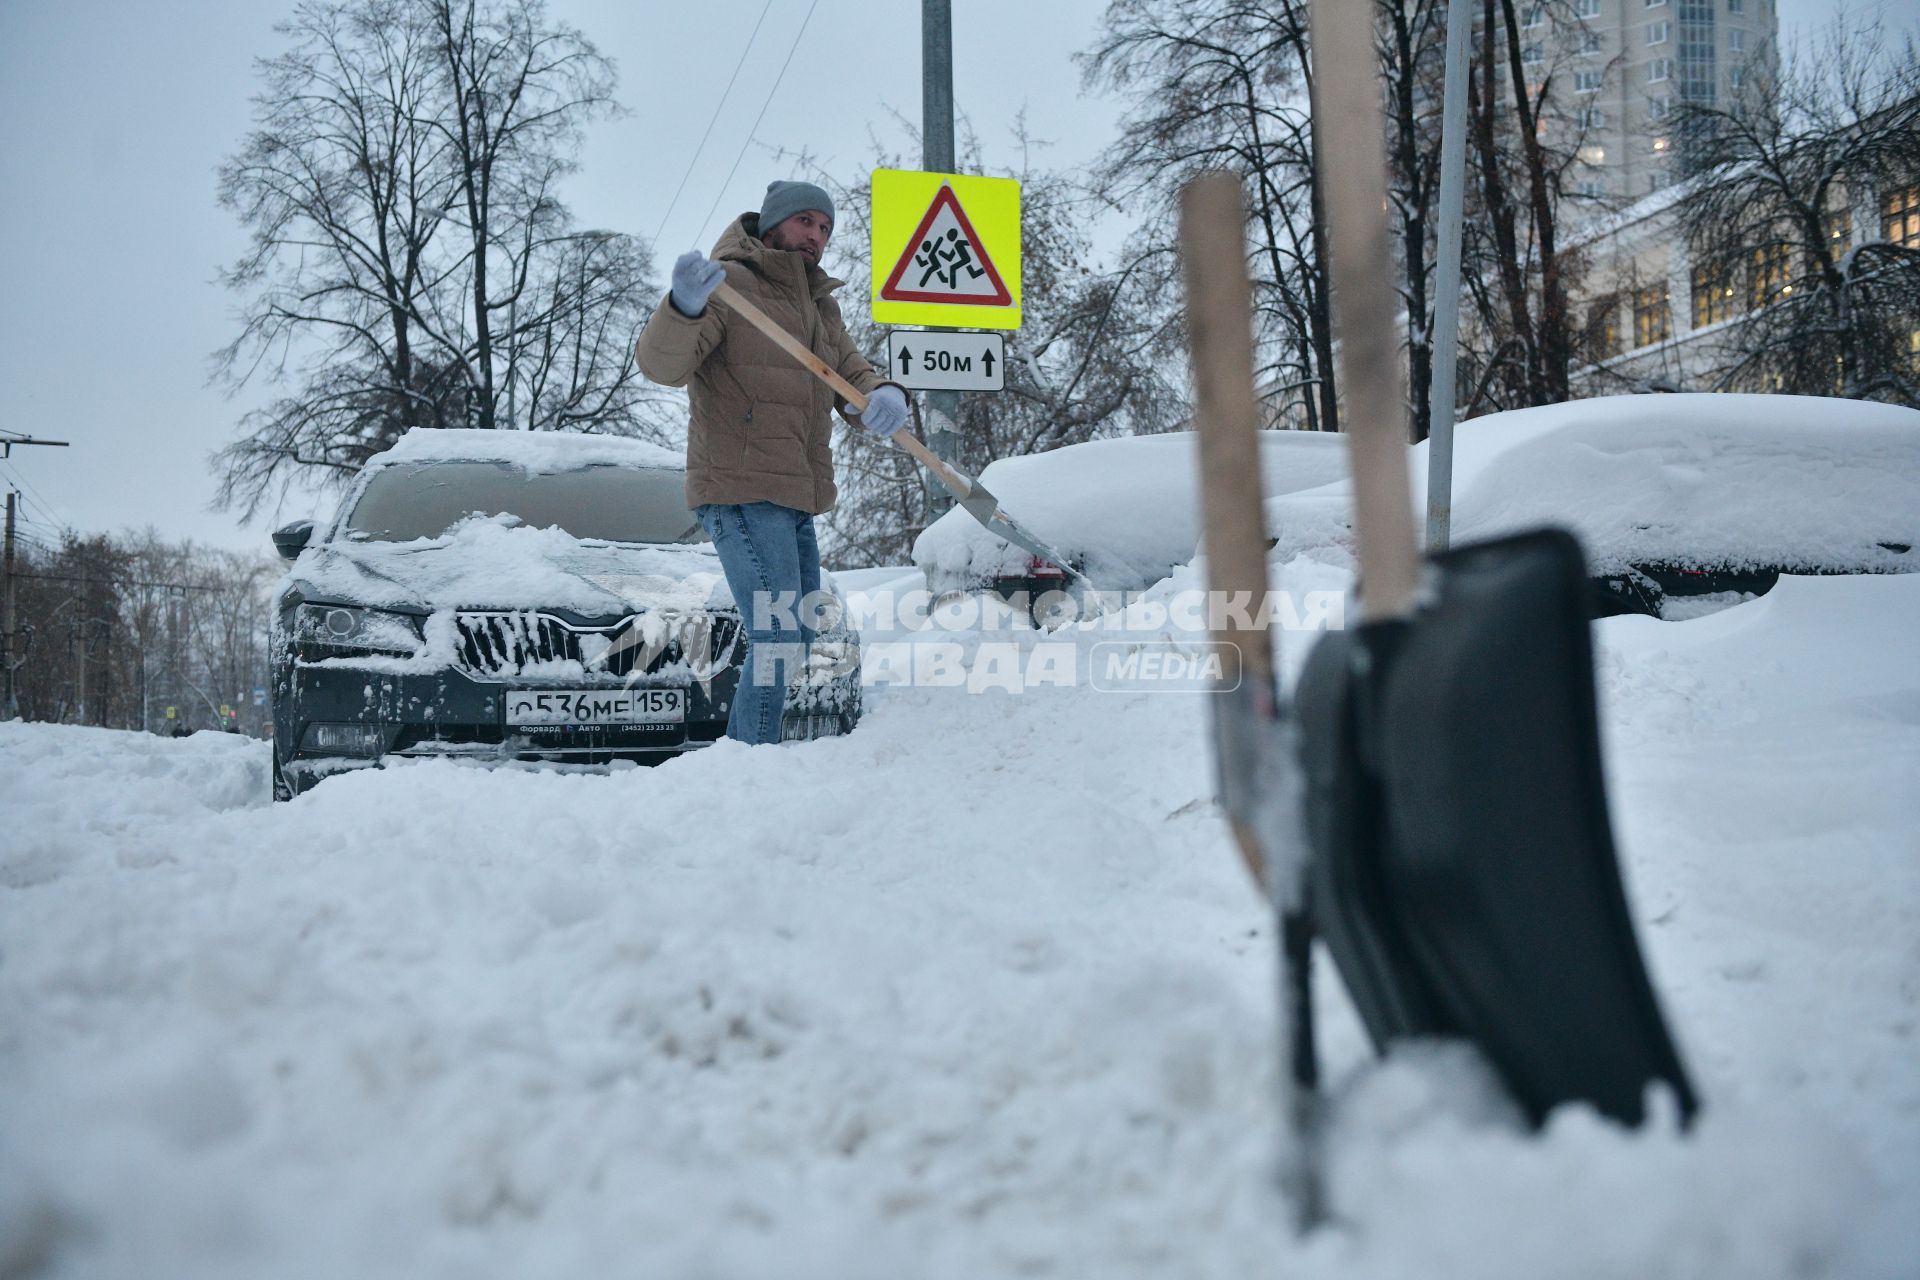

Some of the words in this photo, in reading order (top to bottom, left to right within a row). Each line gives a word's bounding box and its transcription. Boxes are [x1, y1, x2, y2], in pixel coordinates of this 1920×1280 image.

[923, 350, 972, 372] 50м
[520, 725, 561, 733] Форвард
[621, 724, 645, 732] (3452)
